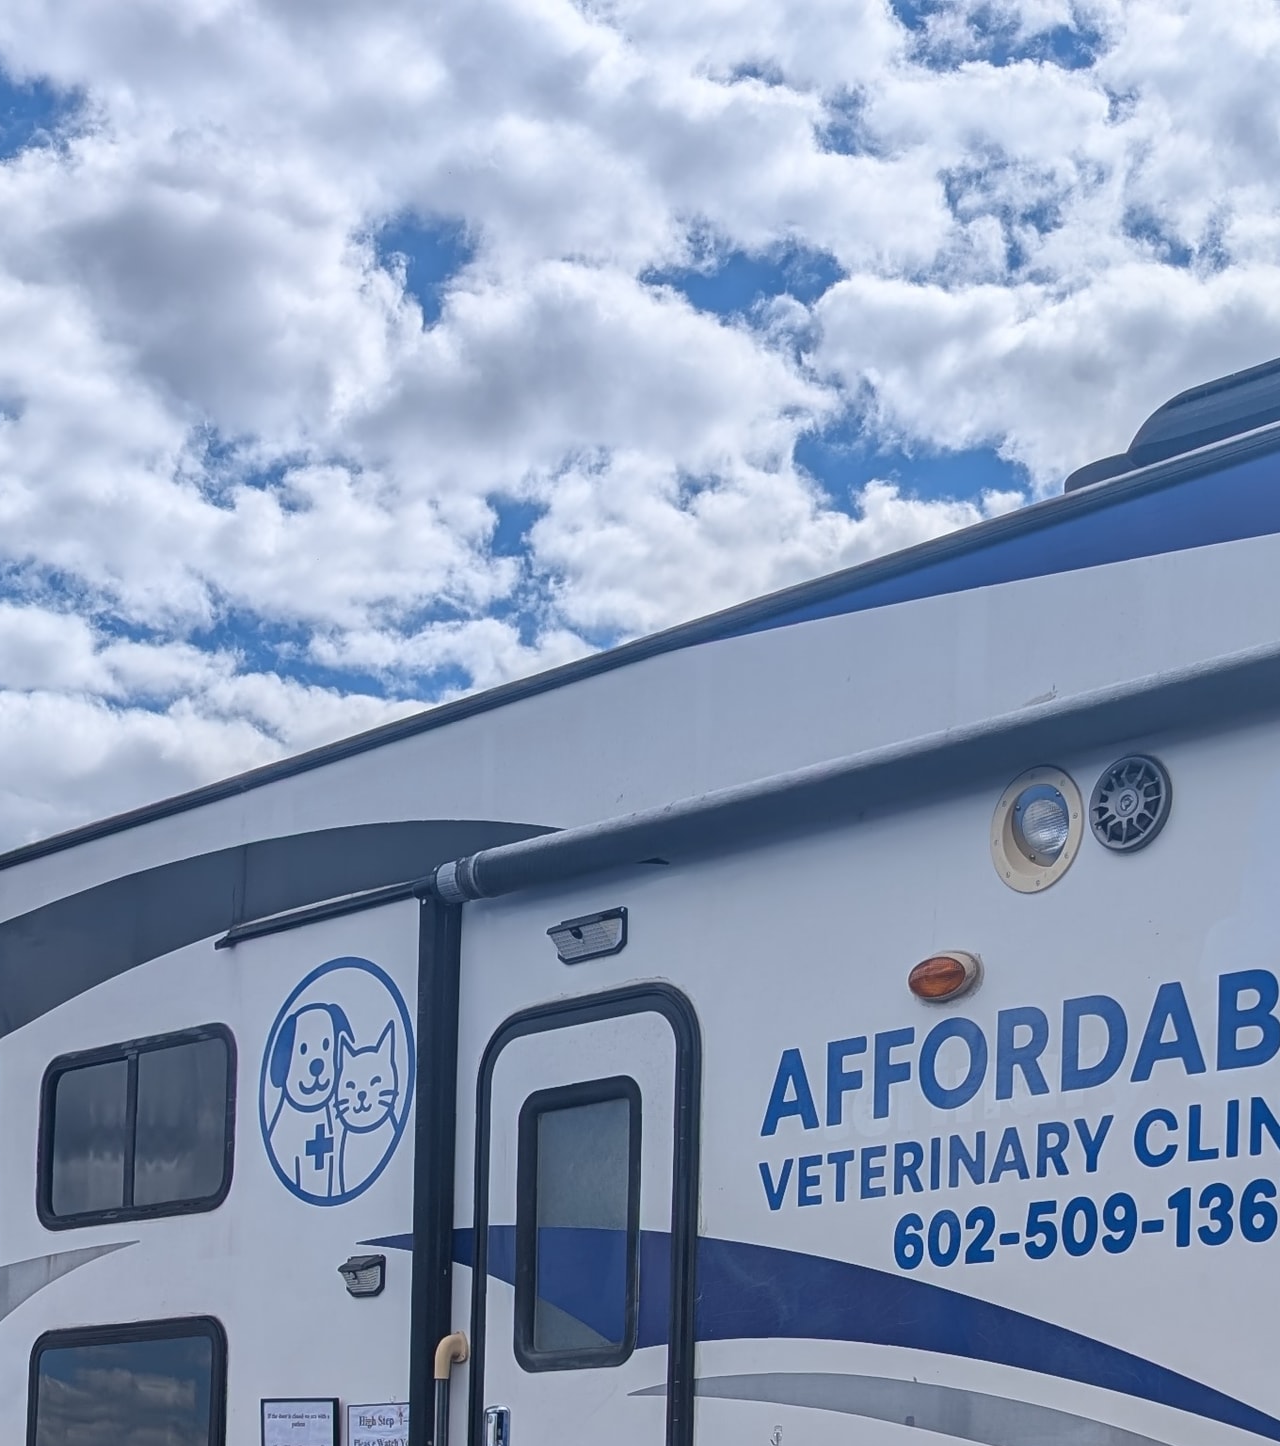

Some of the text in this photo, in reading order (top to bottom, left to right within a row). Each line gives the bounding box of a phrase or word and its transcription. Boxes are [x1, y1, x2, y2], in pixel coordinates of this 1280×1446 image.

[758, 1114, 1115, 1212] VETERINARY
[359, 1415, 395, 1429] High Step
